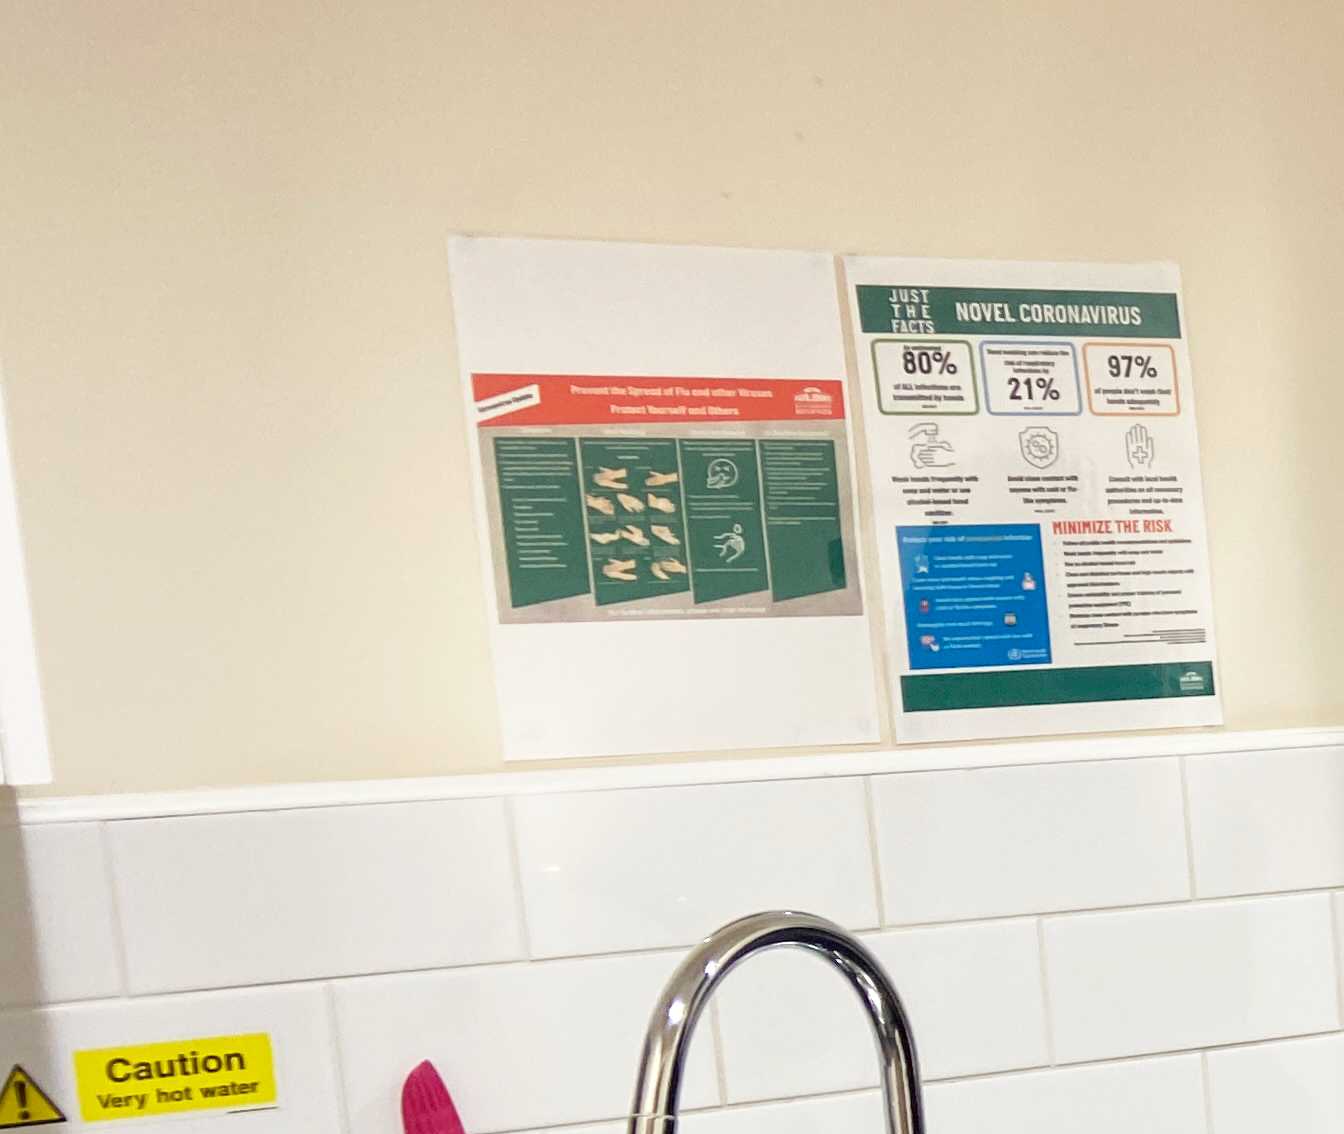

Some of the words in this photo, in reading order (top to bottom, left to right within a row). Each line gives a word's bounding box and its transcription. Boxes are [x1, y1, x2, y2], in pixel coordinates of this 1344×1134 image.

[889, 289, 930, 303] JUST
[891, 303, 931, 319] THE
[955, 302, 1017, 323] NOVEL
[1019, 304, 1142, 326] CORONAVIRUS
[891, 319, 936, 334] FACTS
[902, 351, 958, 375] 80%
[1107, 355, 1159, 378] 97%
[1008, 377, 1061, 401] 21%
[1052, 520, 1114, 535] MINIMIZE
[1114, 519, 1141, 534] THE
[1143, 518, 1174, 533] RISK
[105, 1051, 246, 1083] Caution
[96, 1092, 148, 1110] Very
[156, 1086, 193, 1104] hot
[199, 1080, 260, 1099] water
